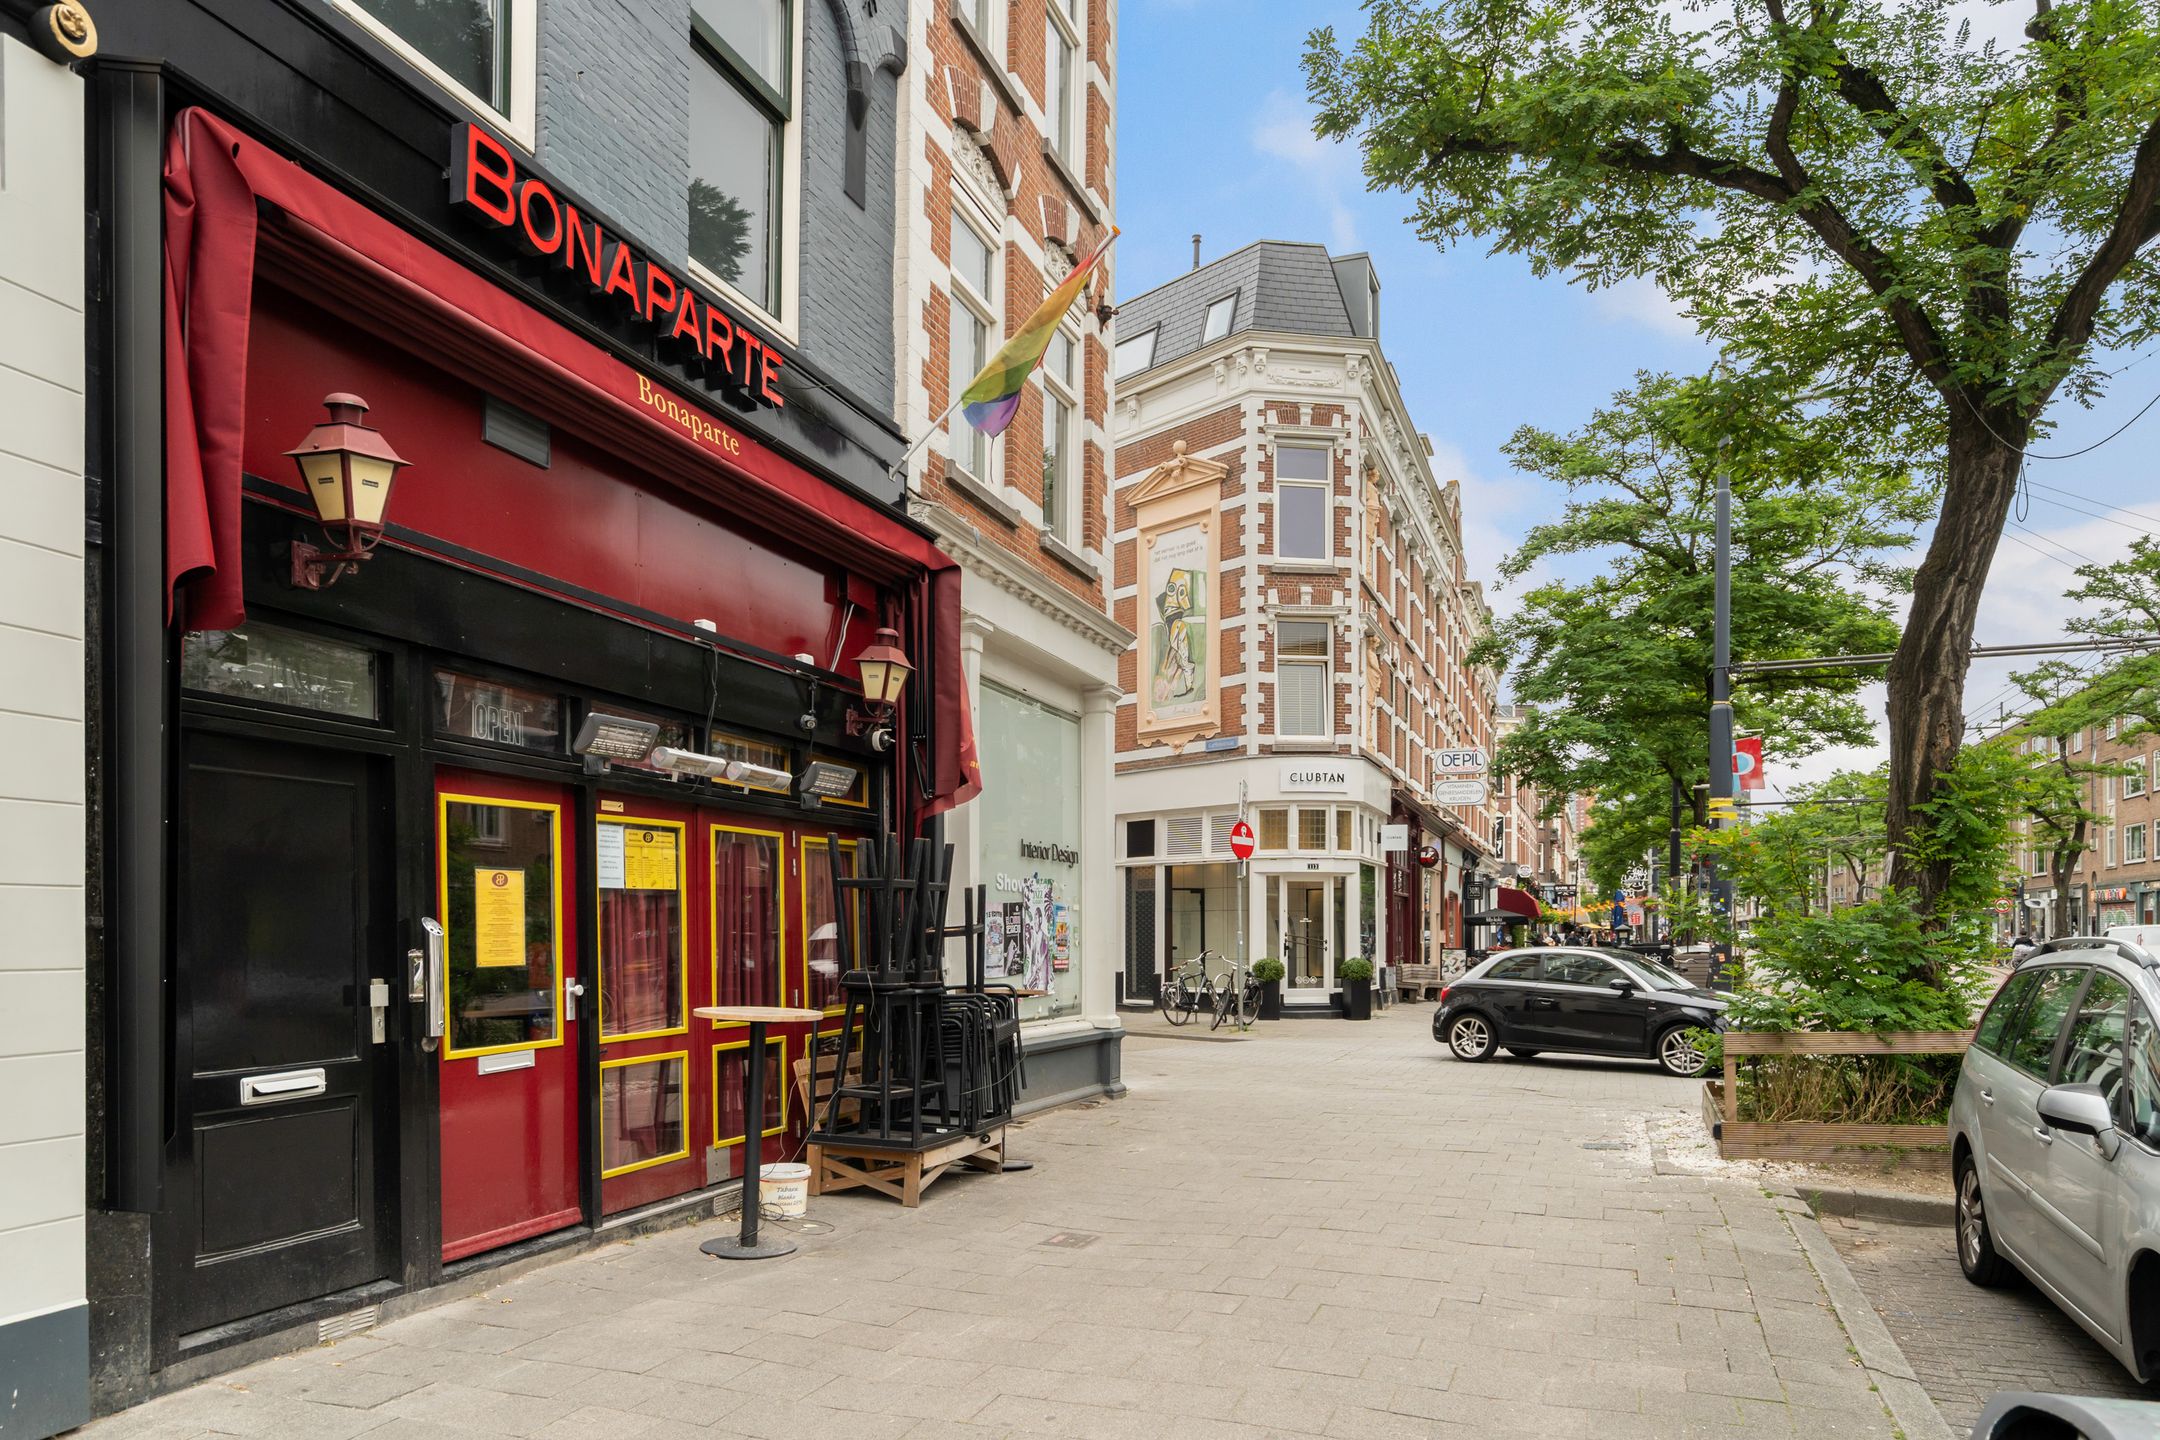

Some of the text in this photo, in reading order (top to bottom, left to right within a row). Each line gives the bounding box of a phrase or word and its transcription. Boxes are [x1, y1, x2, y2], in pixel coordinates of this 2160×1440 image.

[465, 122, 785, 407] BONAPARTE
[636, 372, 739, 455] Bonaparte
[474, 702, 522, 746] OPEN
[1289, 772, 1345, 783] CLUBTAN
[1021, 838, 1079, 868] Interior Design
